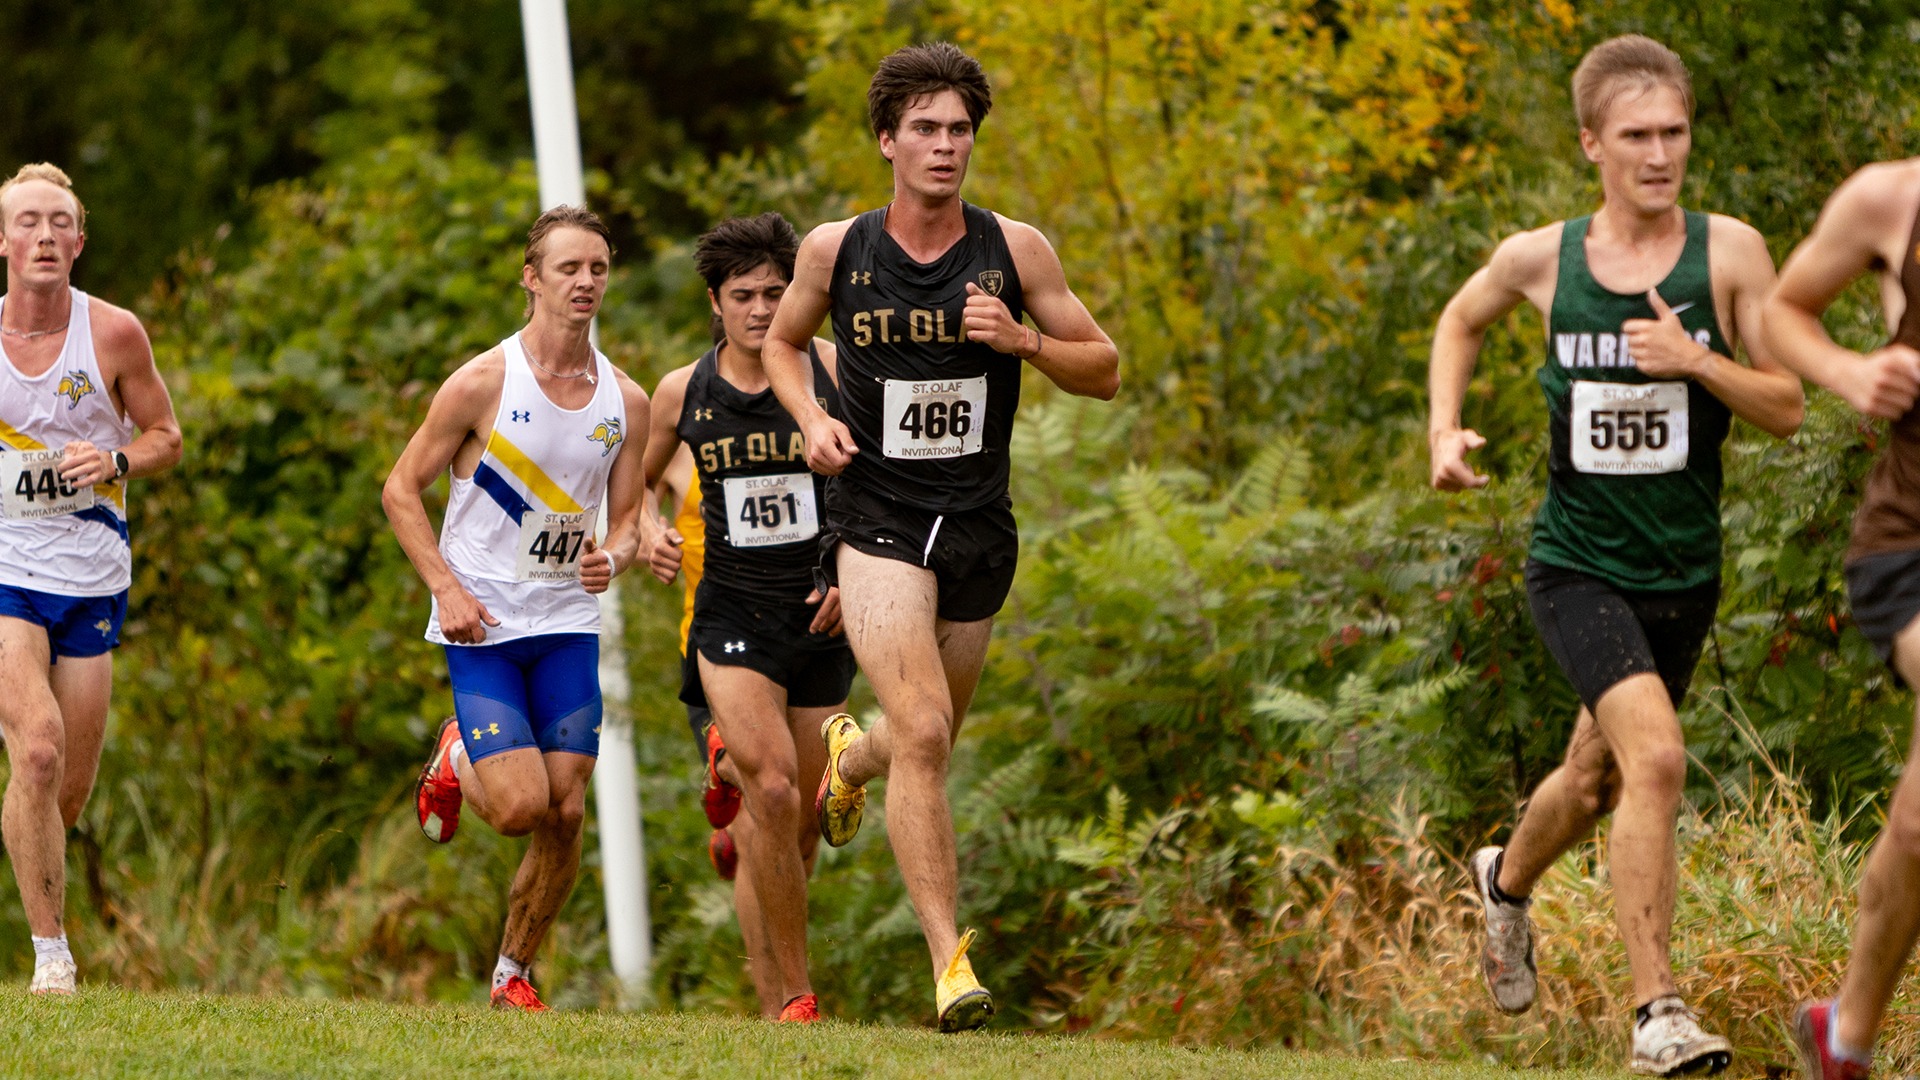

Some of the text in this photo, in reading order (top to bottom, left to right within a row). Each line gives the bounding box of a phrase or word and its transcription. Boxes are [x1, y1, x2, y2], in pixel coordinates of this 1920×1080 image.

[853, 309, 968, 347] ST. OL
[912, 382, 962, 394] ST. OLAF
[899, 400, 972, 439] 466
[1591, 409, 1670, 451] 555
[22, 452, 36, 462] ST.
[700, 431, 807, 473] ST. OLA
[901, 446, 966, 457] INVITATIONAL
[1593, 460, 1664, 470] INVITATIONAL
[745, 476, 789, 489] ST. OLAF
[21, 502, 78, 518] INVITATIONAL
[740, 492, 798, 529] 451
[544, 513, 584, 523] ST. OLAF
[745, 532, 802, 544] INVITATIONAL
[528, 530, 585, 564] 447
[528, 571, 577, 579] INVITATIONAL
